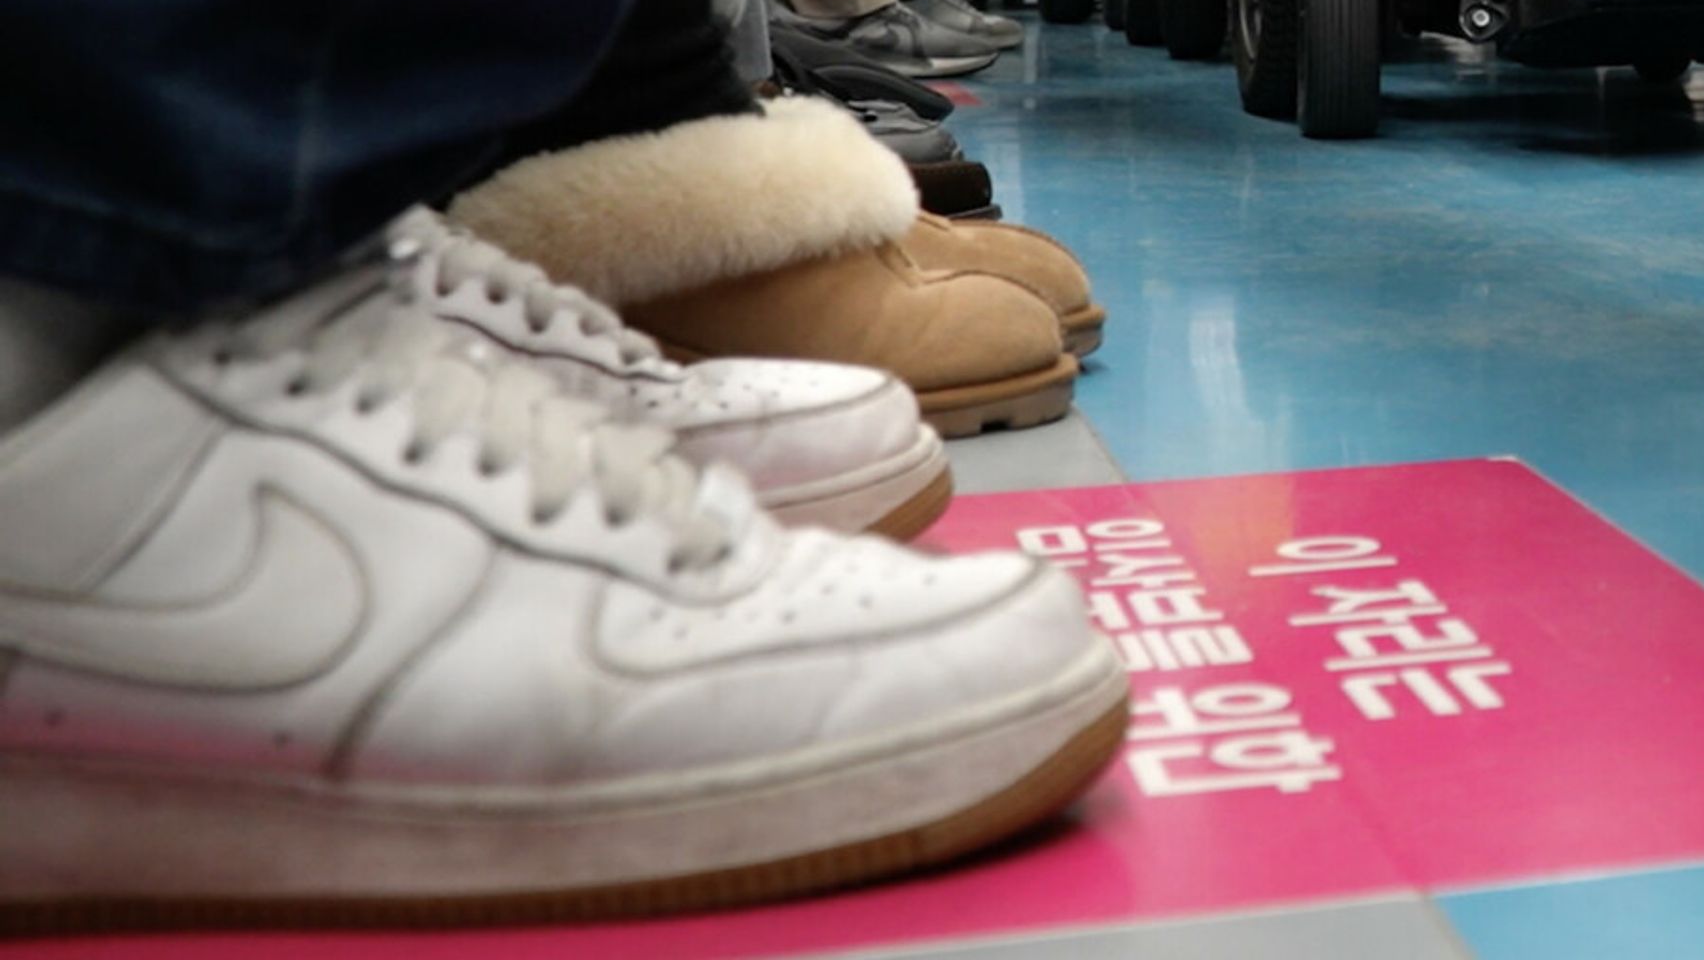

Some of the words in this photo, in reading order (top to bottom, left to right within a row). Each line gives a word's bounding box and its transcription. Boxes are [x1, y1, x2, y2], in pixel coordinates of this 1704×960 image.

[1248, 536, 1398, 577] 이
[1288, 580, 1511, 721] 자리는
[1125, 683, 1342, 797] 위한
